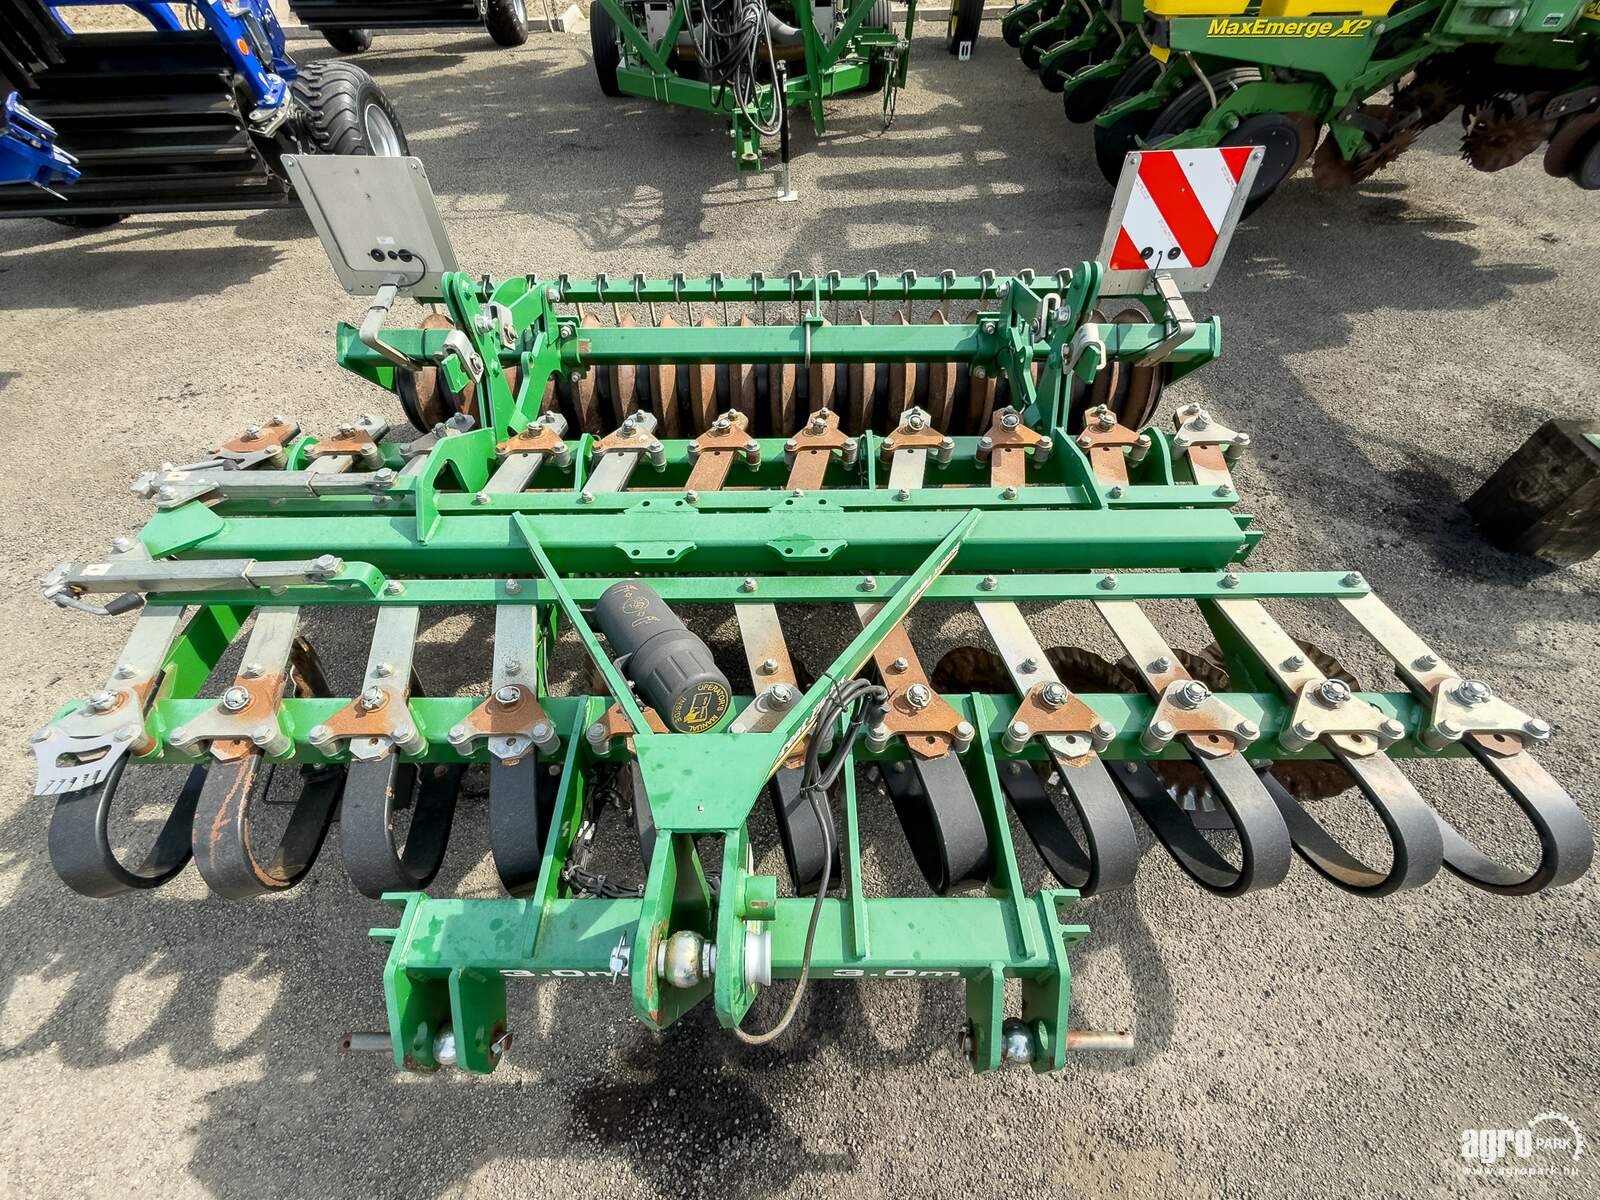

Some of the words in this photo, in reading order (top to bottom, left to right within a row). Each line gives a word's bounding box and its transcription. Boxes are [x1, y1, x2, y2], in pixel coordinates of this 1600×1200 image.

[1207, 19, 1333, 38] MaxEmerge
[1329, 19, 1372, 37] XP
[688, 714, 719, 732] MANUAL
[832, 969, 960, 977] 3.0m
